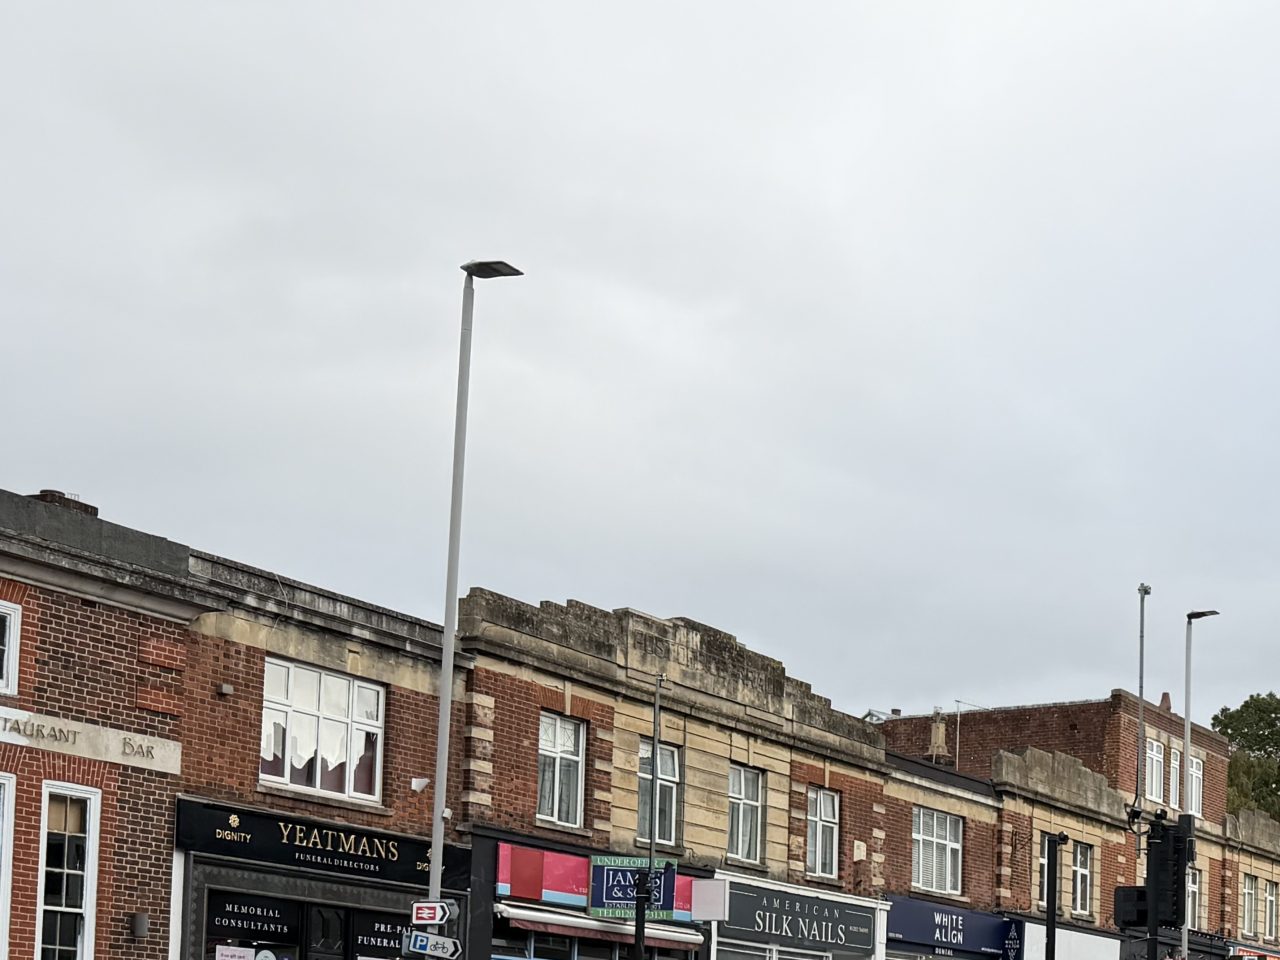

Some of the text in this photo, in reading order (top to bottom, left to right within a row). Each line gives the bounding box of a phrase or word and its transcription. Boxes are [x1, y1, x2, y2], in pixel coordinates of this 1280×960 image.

[122, 736, 155, 760] BAR
[215, 828, 251, 844] DIGNITY
[278, 821, 399, 862] YEATMANS
[295, 852, 380, 873] FUNERAL DIRECTORS
[612, 887, 624, 898] &
[225, 903, 281, 919] MEMORIAL
[762, 896, 839, 919] AMERICAN
[215, 916, 289, 934] CONSULTANTS
[374, 922, 417, 934] PRE-PAI
[754, 909, 846, 945] SILK NAILS
[934, 911, 964, 929] WHITE
[357, 935, 401, 949] FUNERAL
[934, 927, 964, 945] ALIGN
[934, 947, 954, 957] DENTAL
